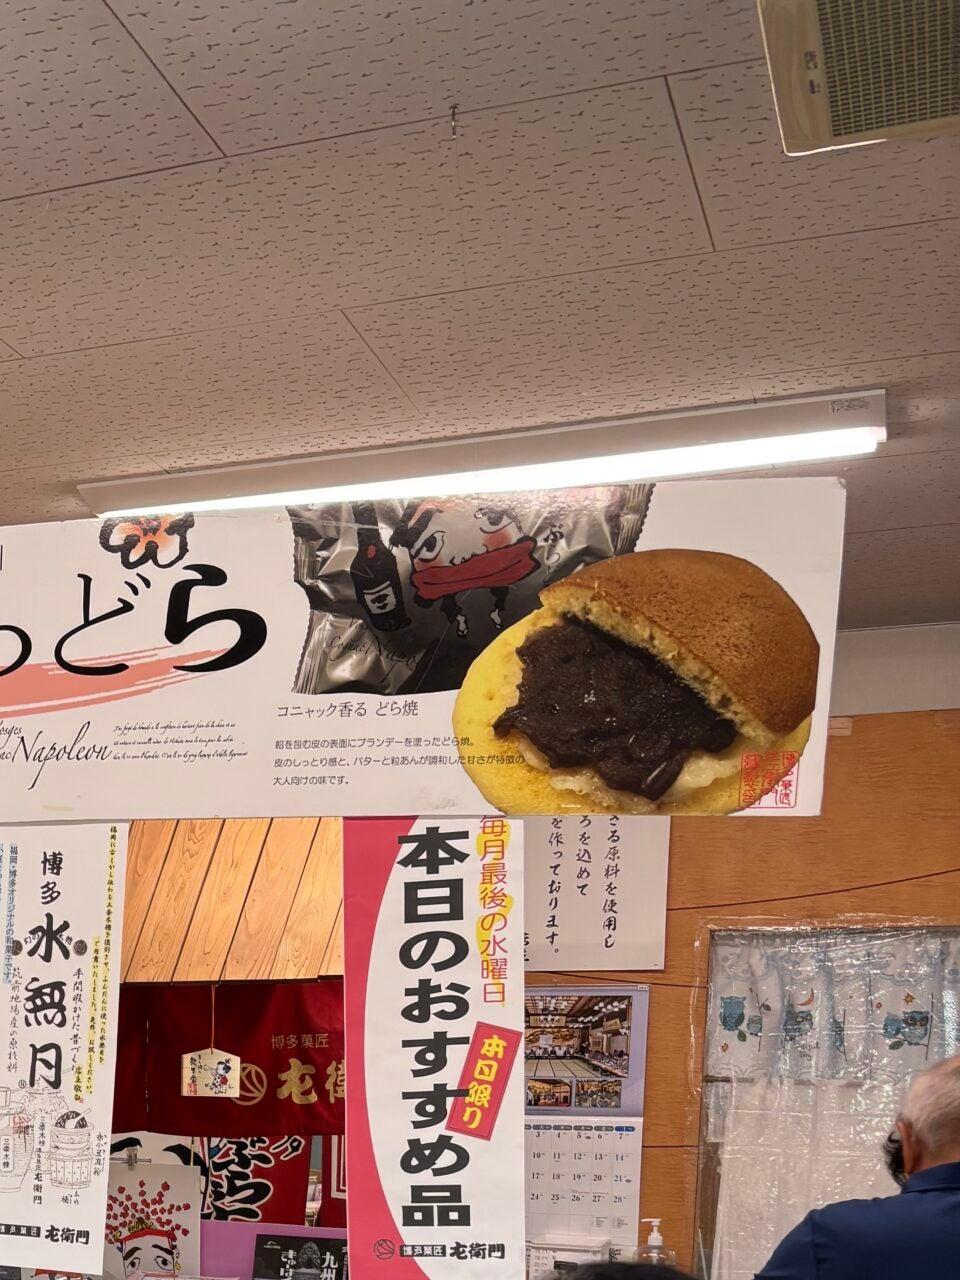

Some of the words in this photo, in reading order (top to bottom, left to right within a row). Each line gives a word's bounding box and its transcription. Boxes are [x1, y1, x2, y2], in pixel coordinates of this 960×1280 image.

[277, 701, 367, 718] コニャック香る
[375, 700, 419, 717] どら焼
[11, 720, 112, 791] Napoleon
[480, 816, 508, 1004] 毎月最後の水曜日
[271, 1033, 329, 1050] 博多菓匠
[396, 826, 472, 1227] 本日のおすすめ品
[461, 1034, 508, 1130] 本日限り
